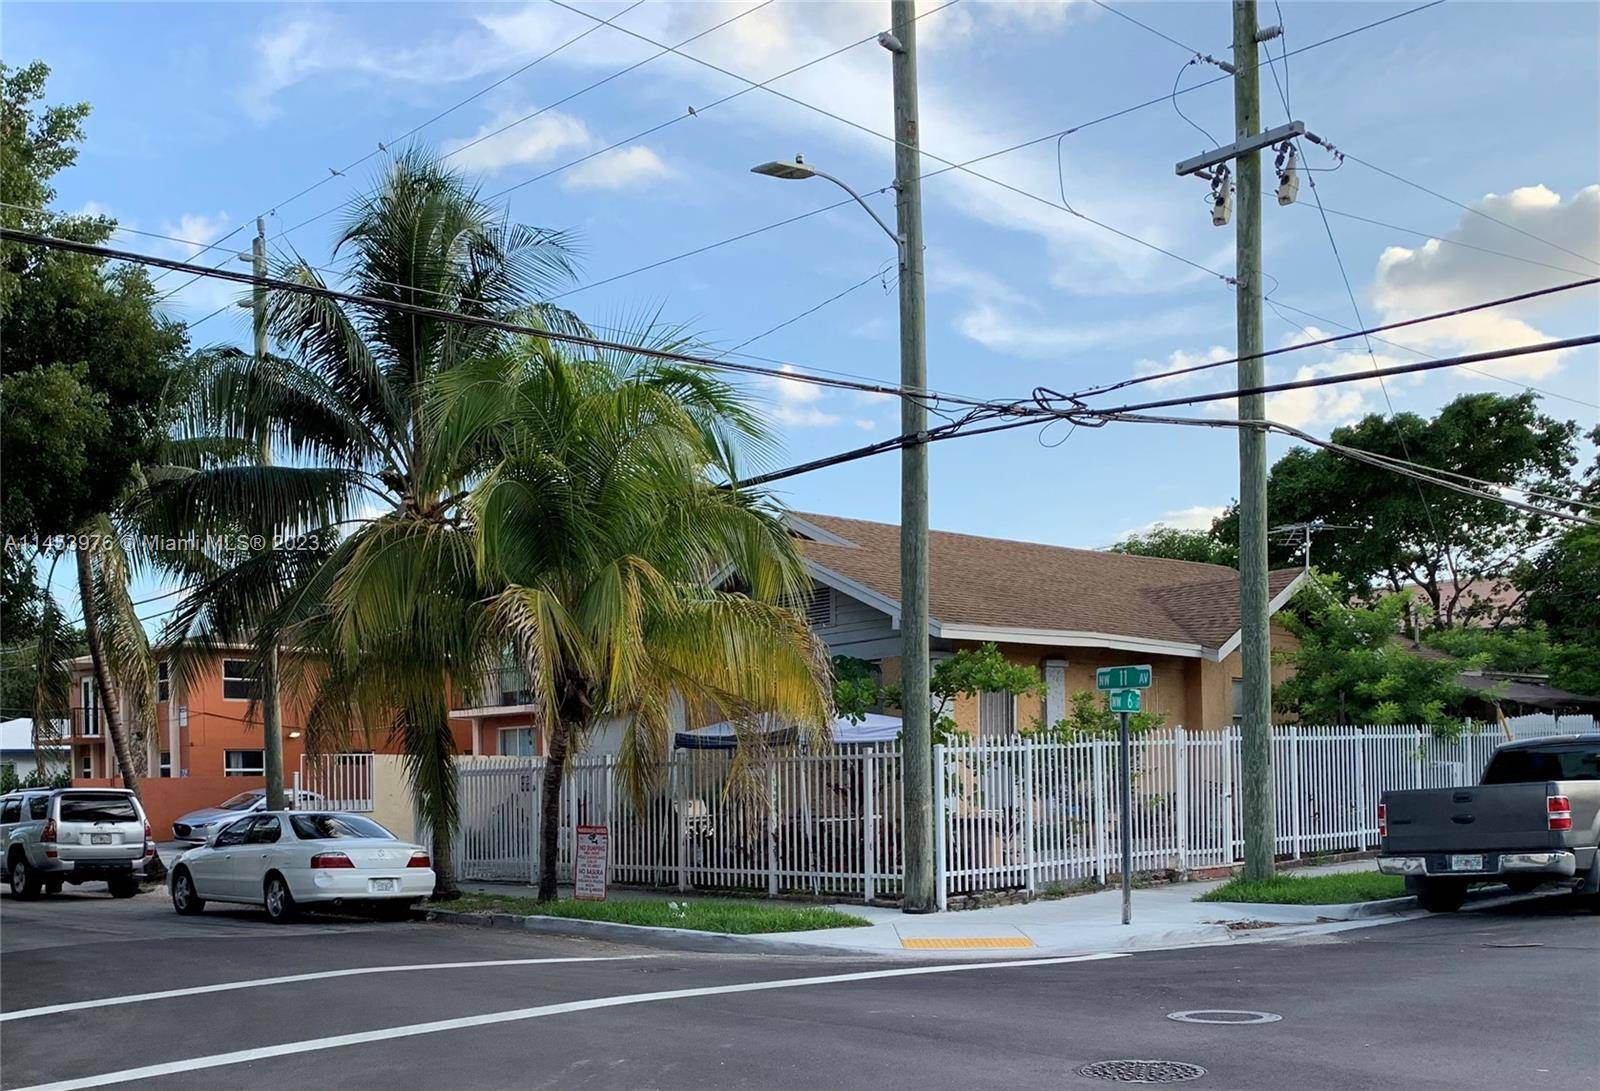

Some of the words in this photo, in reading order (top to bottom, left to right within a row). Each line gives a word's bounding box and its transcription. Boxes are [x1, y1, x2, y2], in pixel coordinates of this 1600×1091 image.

[1099, 674, 1110, 686] NW
[1120, 670, 1127, 686] 11
[1138, 672, 1148, 684] AV
[1112, 696, 1121, 708] NW
[1127, 693, 1133, 709] 6
